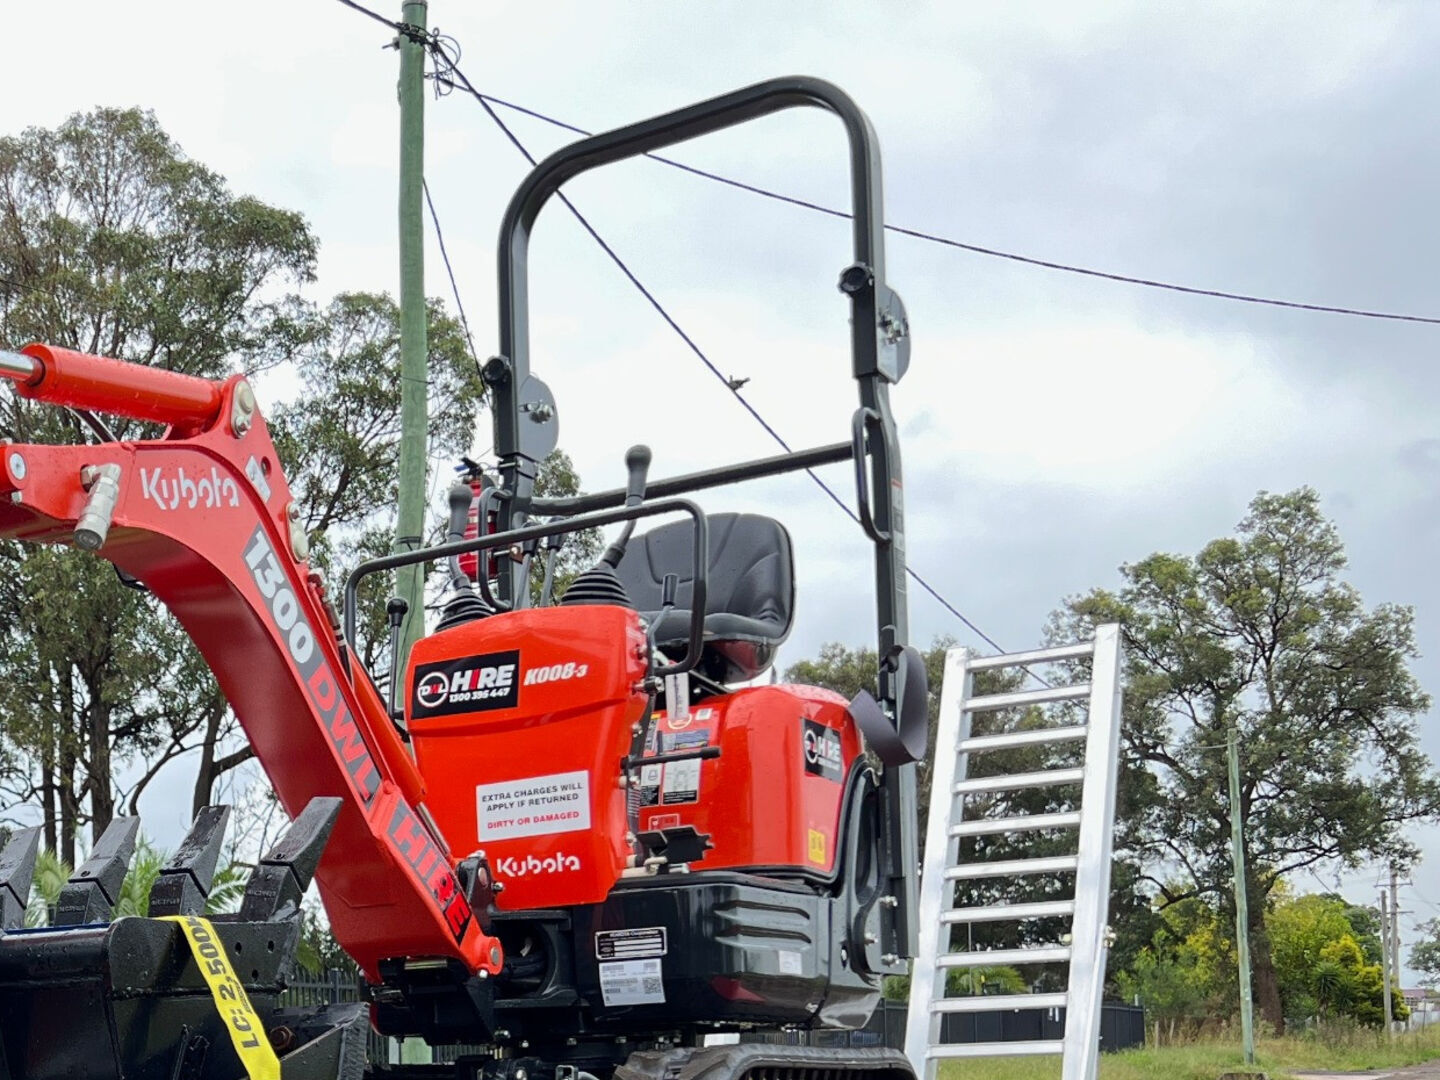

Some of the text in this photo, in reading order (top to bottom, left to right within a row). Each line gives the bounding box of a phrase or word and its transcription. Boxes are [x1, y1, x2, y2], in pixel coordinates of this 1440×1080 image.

[140, 467, 239, 510] Kubota
[451, 664, 516, 692] HIRE
[245, 530, 471, 937] 1300 DWL HIRE
[482, 782, 583, 802] EXTRA CHARGES WILL
[486, 793, 579, 812] APPLY IF RETURNED
[487, 811, 580, 829] DIRTY OR DAMAGED
[497, 852, 580, 877] Kubota
